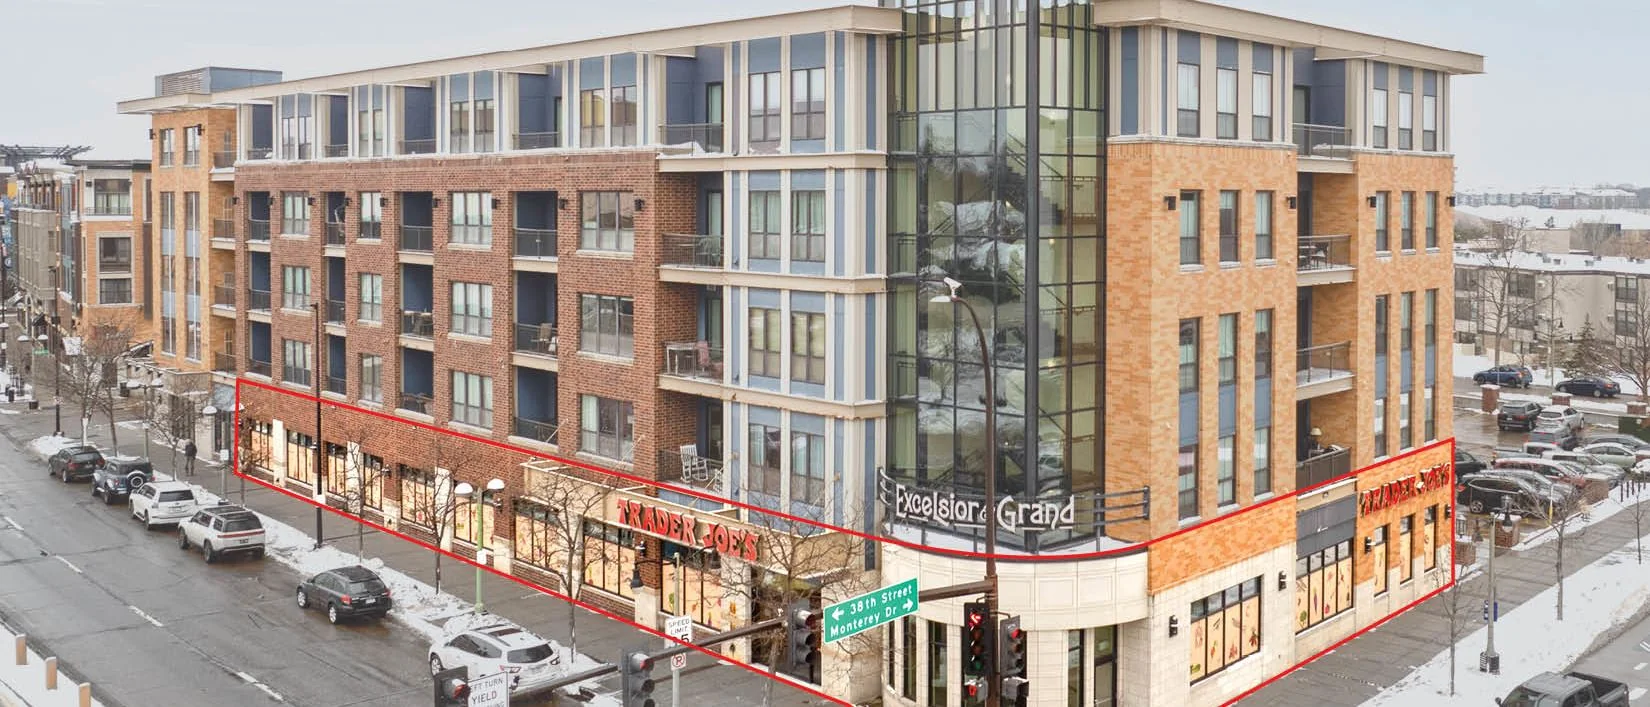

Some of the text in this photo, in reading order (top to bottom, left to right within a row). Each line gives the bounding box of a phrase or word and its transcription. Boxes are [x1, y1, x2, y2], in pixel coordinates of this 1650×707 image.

[1360, 475, 1416, 516] TRADER
[996, 494, 1075, 533] Grand
[616, 497, 760, 562] TRADER JOE'S
[850, 584, 912, 615] 38th Street
[668, 618, 690, 629] SPEED
[670, 625, 688, 635] LIMIT
[830, 606, 897, 637] Monterey Dr
[471, 690, 497, 704] YIELD
[485, 678, 503, 688] TURN
